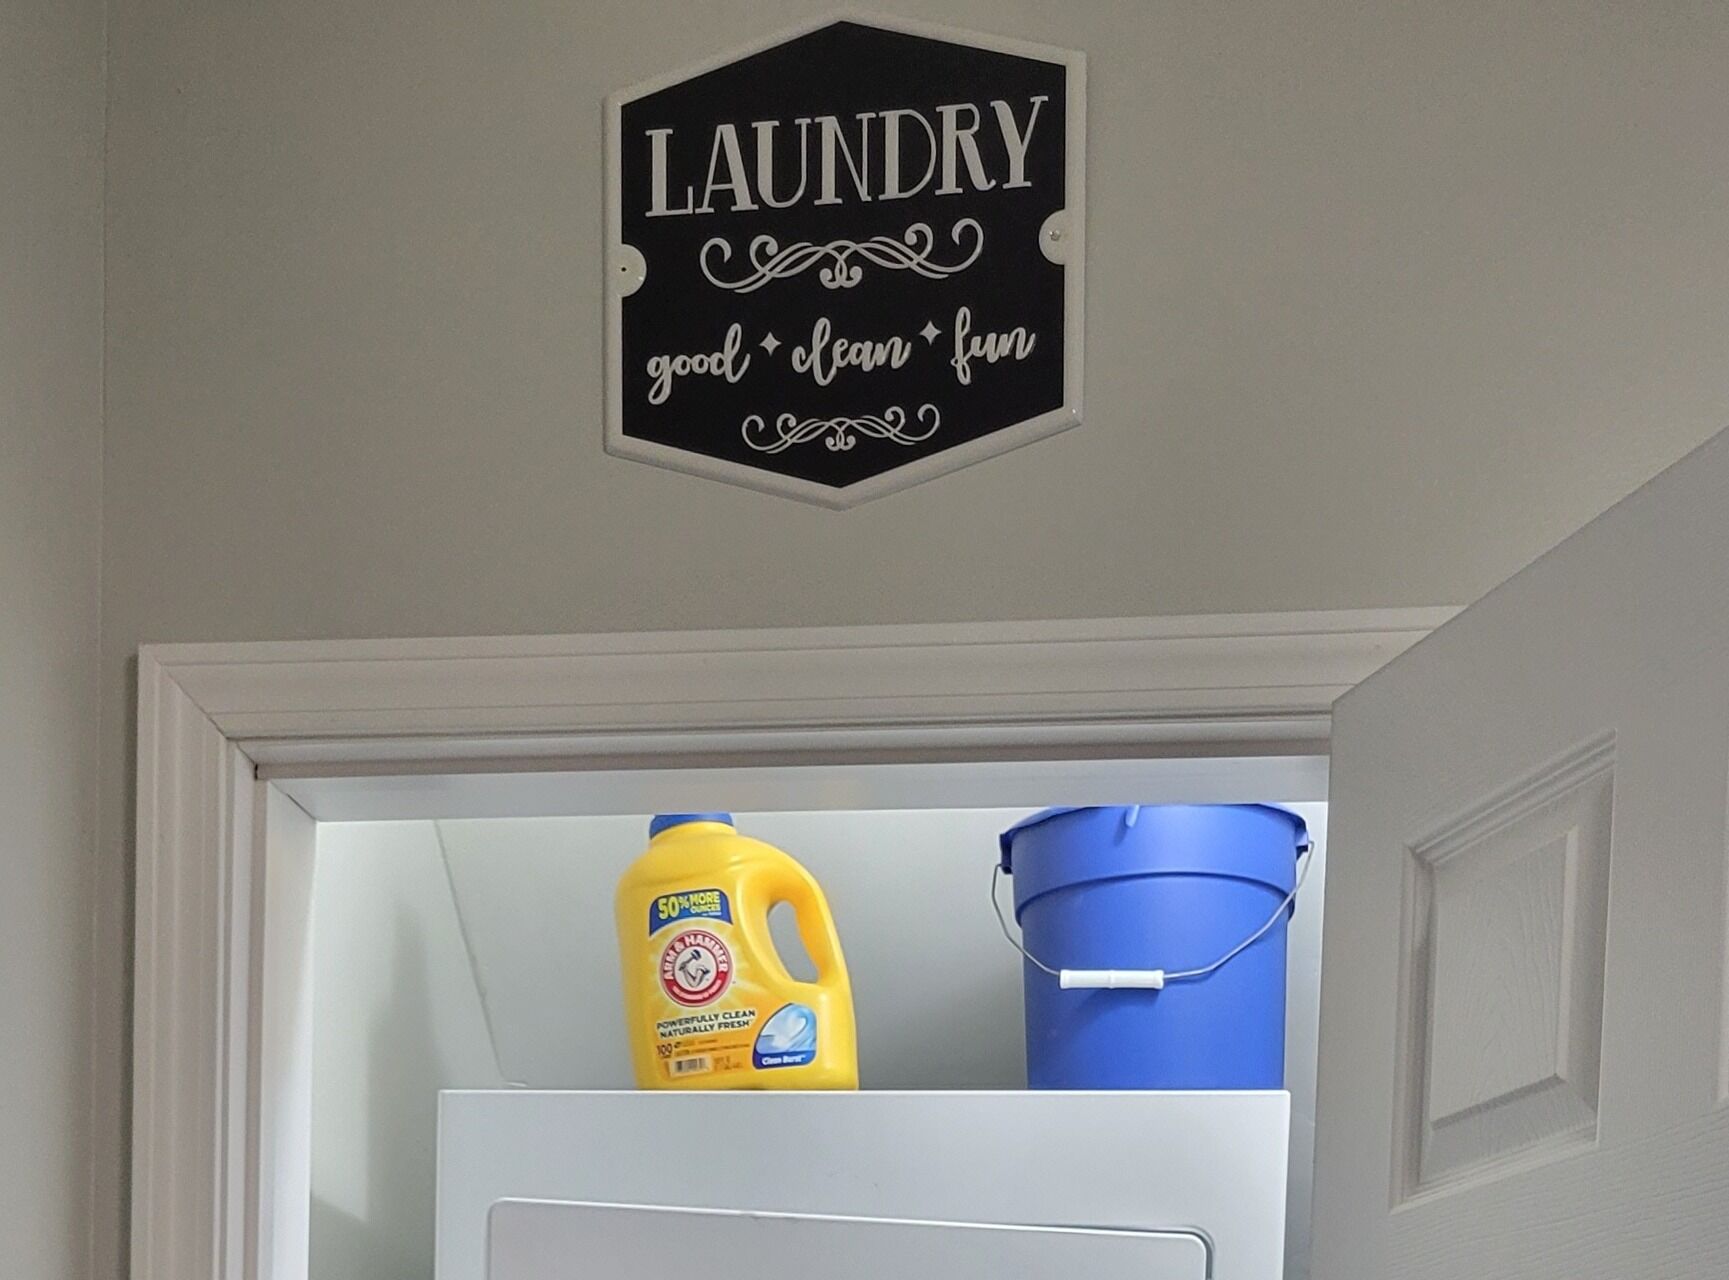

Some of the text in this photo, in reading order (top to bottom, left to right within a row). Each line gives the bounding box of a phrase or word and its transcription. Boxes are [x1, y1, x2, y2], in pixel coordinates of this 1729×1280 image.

[645, 96, 1049, 218] LAUNDRY
[647, 307, 1036, 405] good clean fun
[658, 891, 721, 919] 50% MORE
[663, 949, 679, 980] ARM
[683, 934, 728, 973] HAMMER
[656, 1009, 756, 1030] POWERFULLY CLEAN
[660, 1023, 715, 1038] NATURALLY
